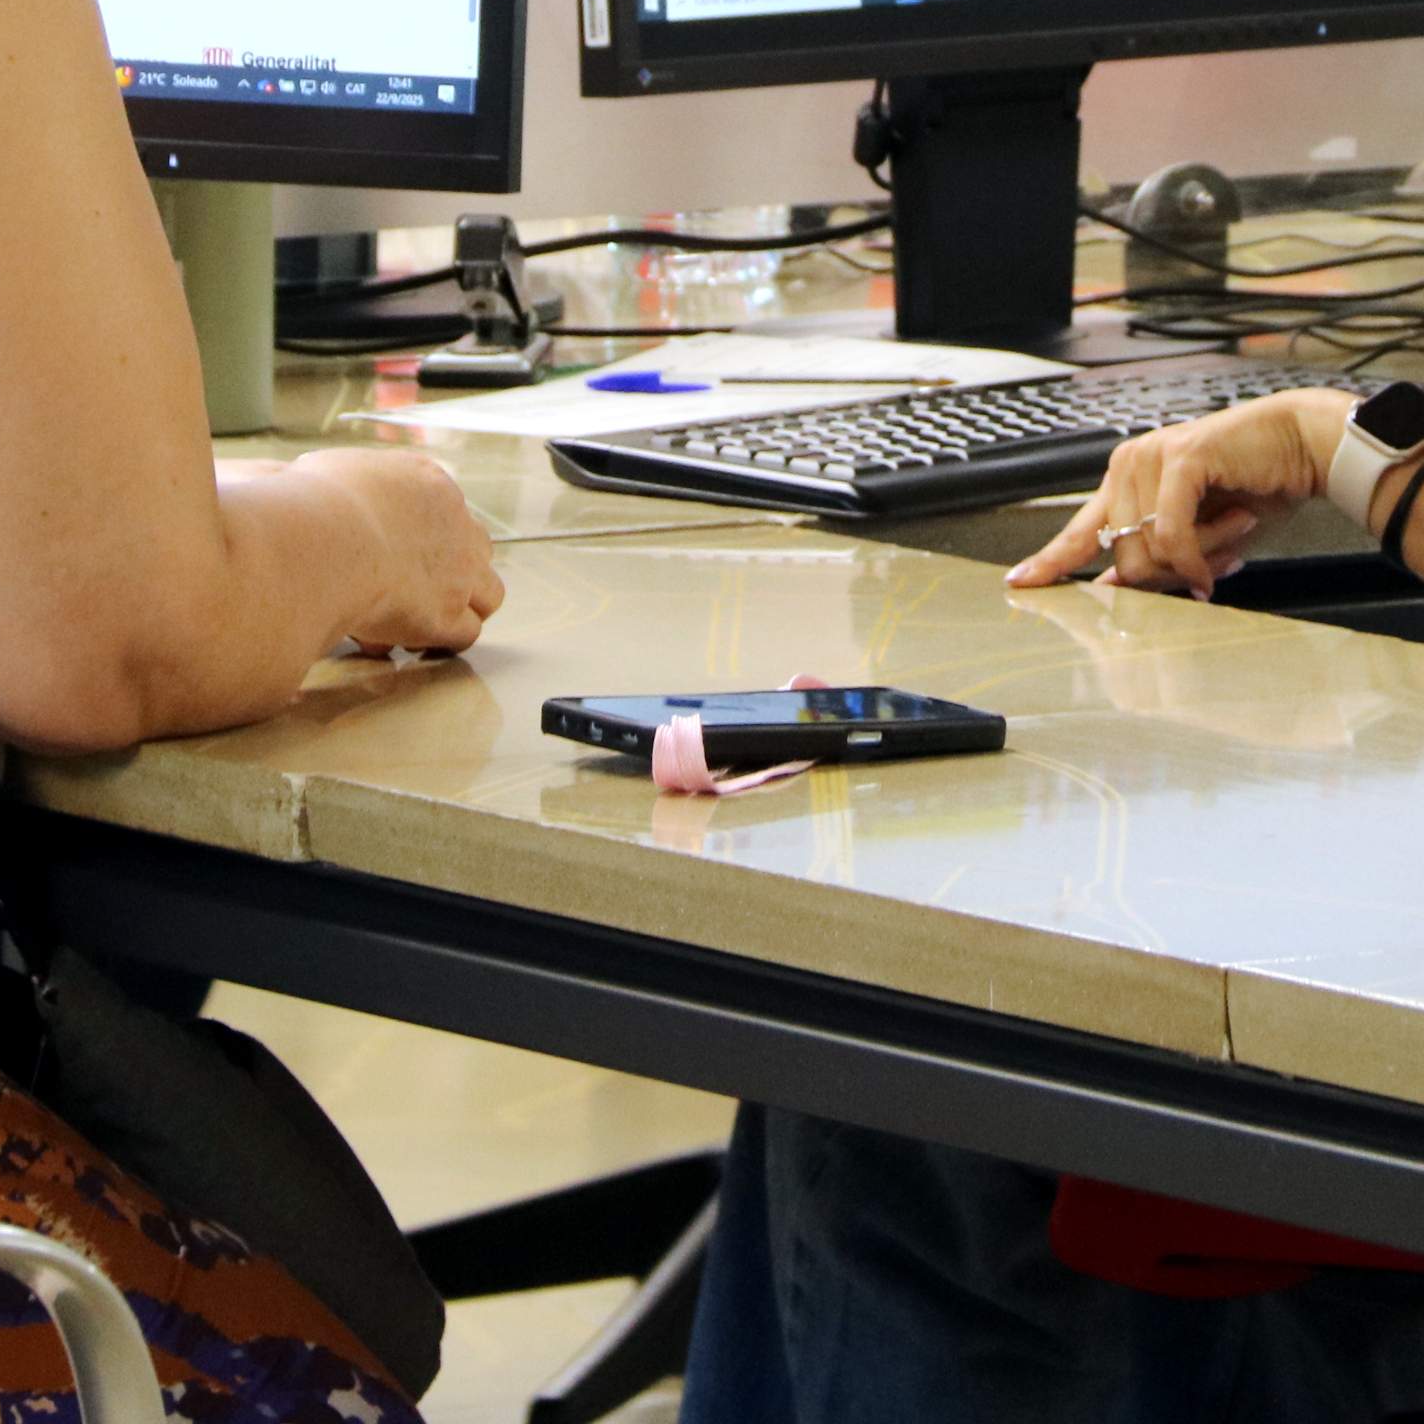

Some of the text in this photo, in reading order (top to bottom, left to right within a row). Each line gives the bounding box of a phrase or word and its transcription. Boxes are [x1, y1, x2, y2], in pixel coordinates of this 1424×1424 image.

[241, 51, 338, 72] Generalitat
[172, 73, 219, 90] Soleado
[345, 81, 367, 96] CAT
